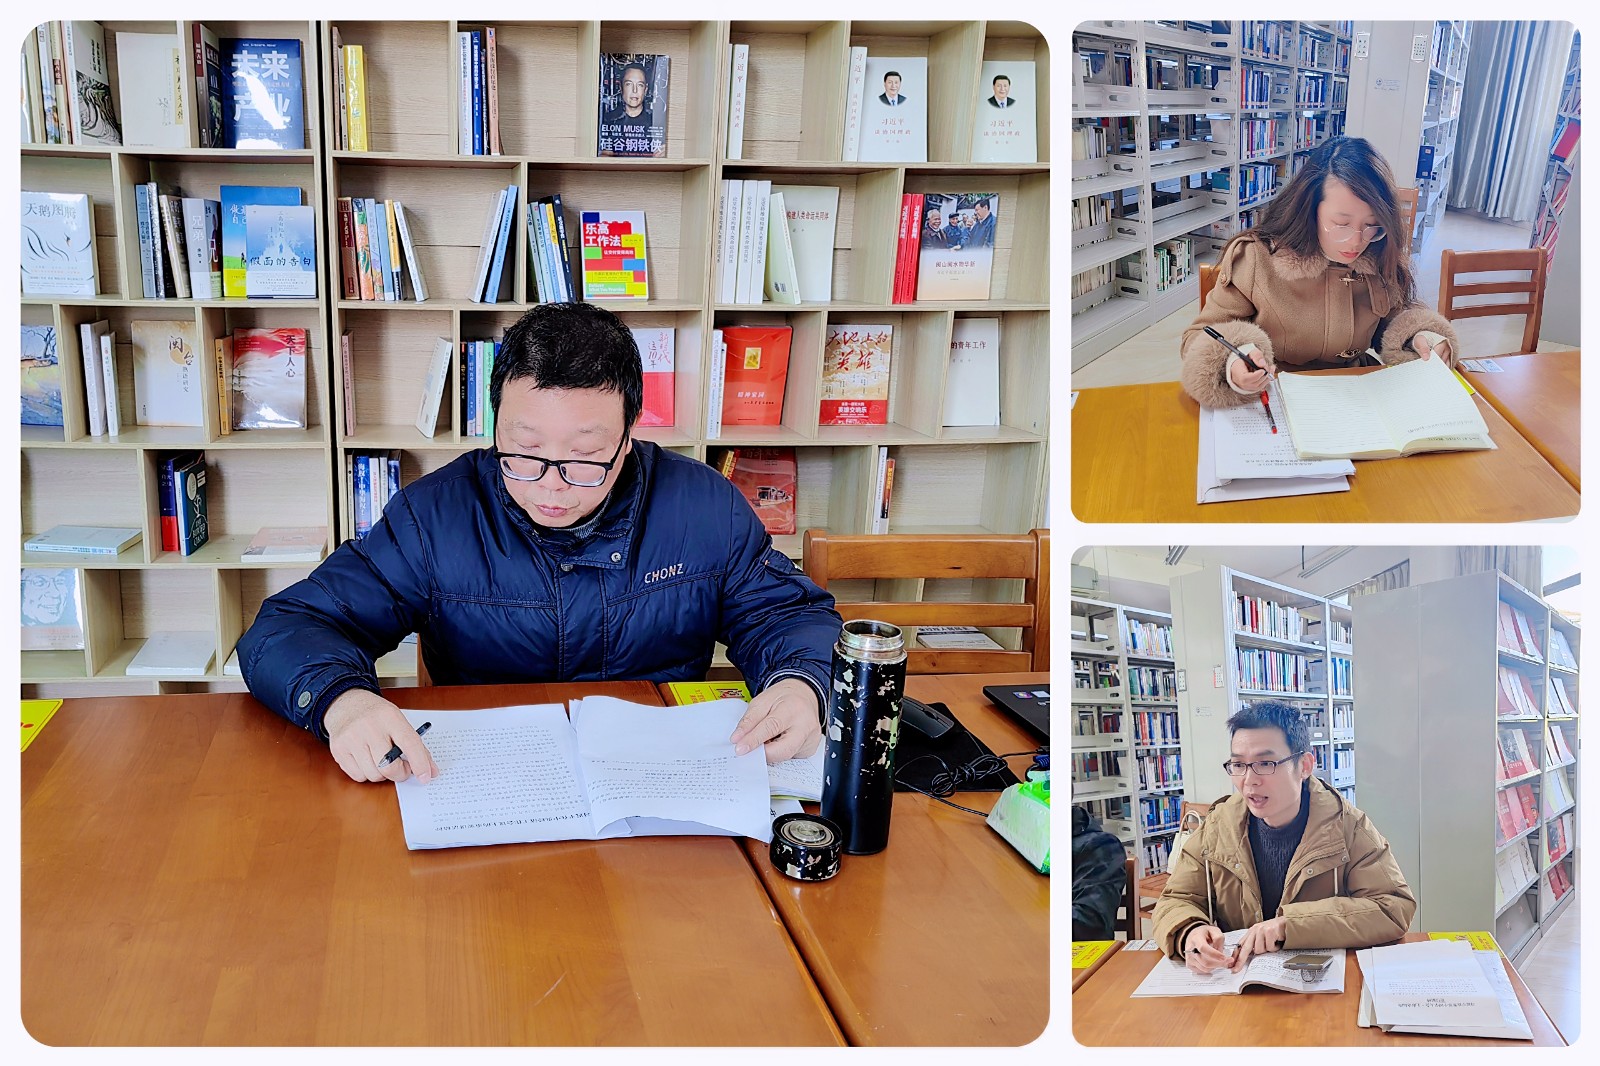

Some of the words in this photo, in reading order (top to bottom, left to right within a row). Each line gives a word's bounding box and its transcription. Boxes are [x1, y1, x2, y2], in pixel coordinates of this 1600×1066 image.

[231, 50, 290, 81] 未来
[736, 52, 745, 84] 习近平
[854, 53, 863, 84] 习近平
[601, 124, 622, 132] ELON
[623, 125, 645, 133] MUSK
[881, 117, 906, 126] 习近平
[989, 120, 1014, 128] 习近平
[600, 137, 663, 153] 硅谷钢铁侠
[24, 202, 77, 219] 天鹅图腾
[192, 215, 205, 241] 兄弟
[585, 223, 610, 235] 乐高
[585, 235, 622, 247] 工作法
[250, 256, 312, 267] 假面的告白
[825, 329, 888, 348] 大地上的
[951, 340, 987, 350] 的青年工作
[285, 334, 296, 378] 天下人心
[648, 340, 657, 369] 这10年
[836, 350, 874, 372] 英雄
[644, 563, 684, 584] CHONZ
